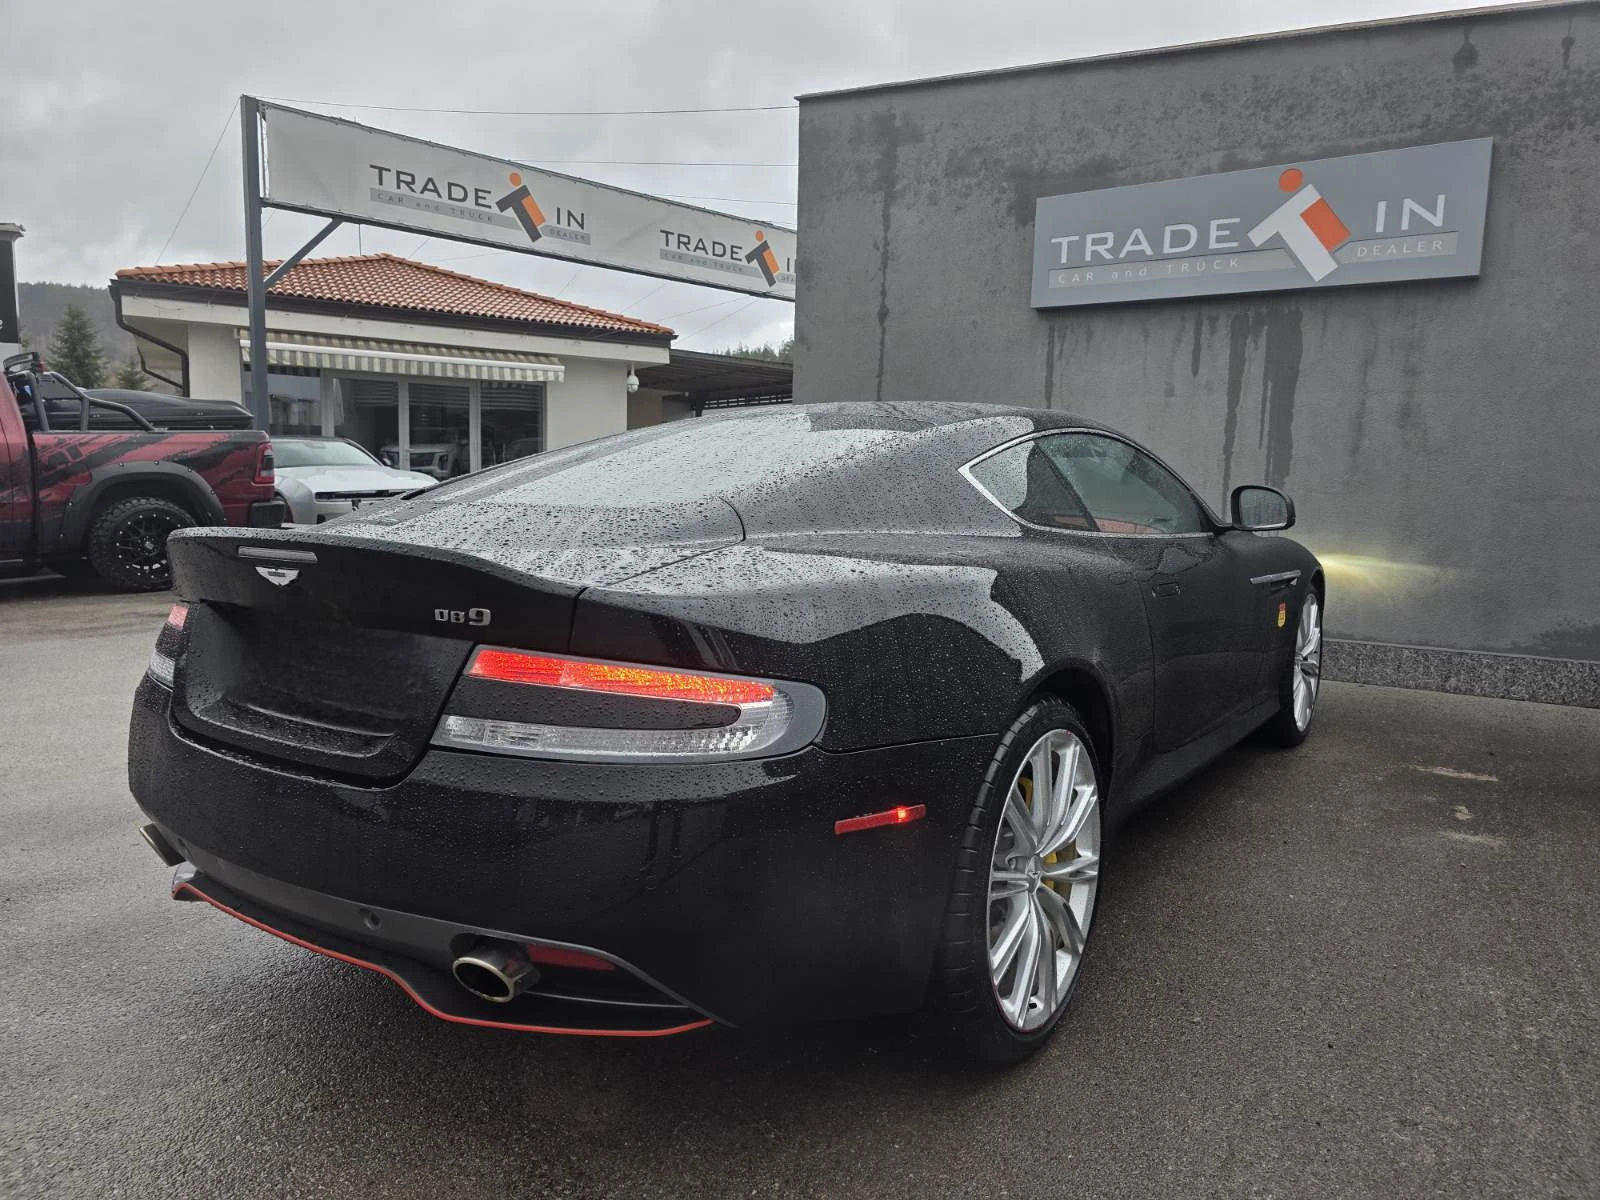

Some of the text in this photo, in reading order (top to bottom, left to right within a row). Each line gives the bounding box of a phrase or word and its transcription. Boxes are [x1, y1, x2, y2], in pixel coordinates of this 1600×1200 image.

[369, 164, 585, 231] TRADE IN
[377, 192, 404, 204] CAR
[451, 207, 493, 222] TRUCK
[550, 228, 585, 241] DEALER
[660, 229, 743, 262] TRADE
[1051, 194, 1445, 264] TRADE IN
[1058, 240, 1442, 284] CAR and TRUCK DEALER
[434, 607, 491, 626] DB9
